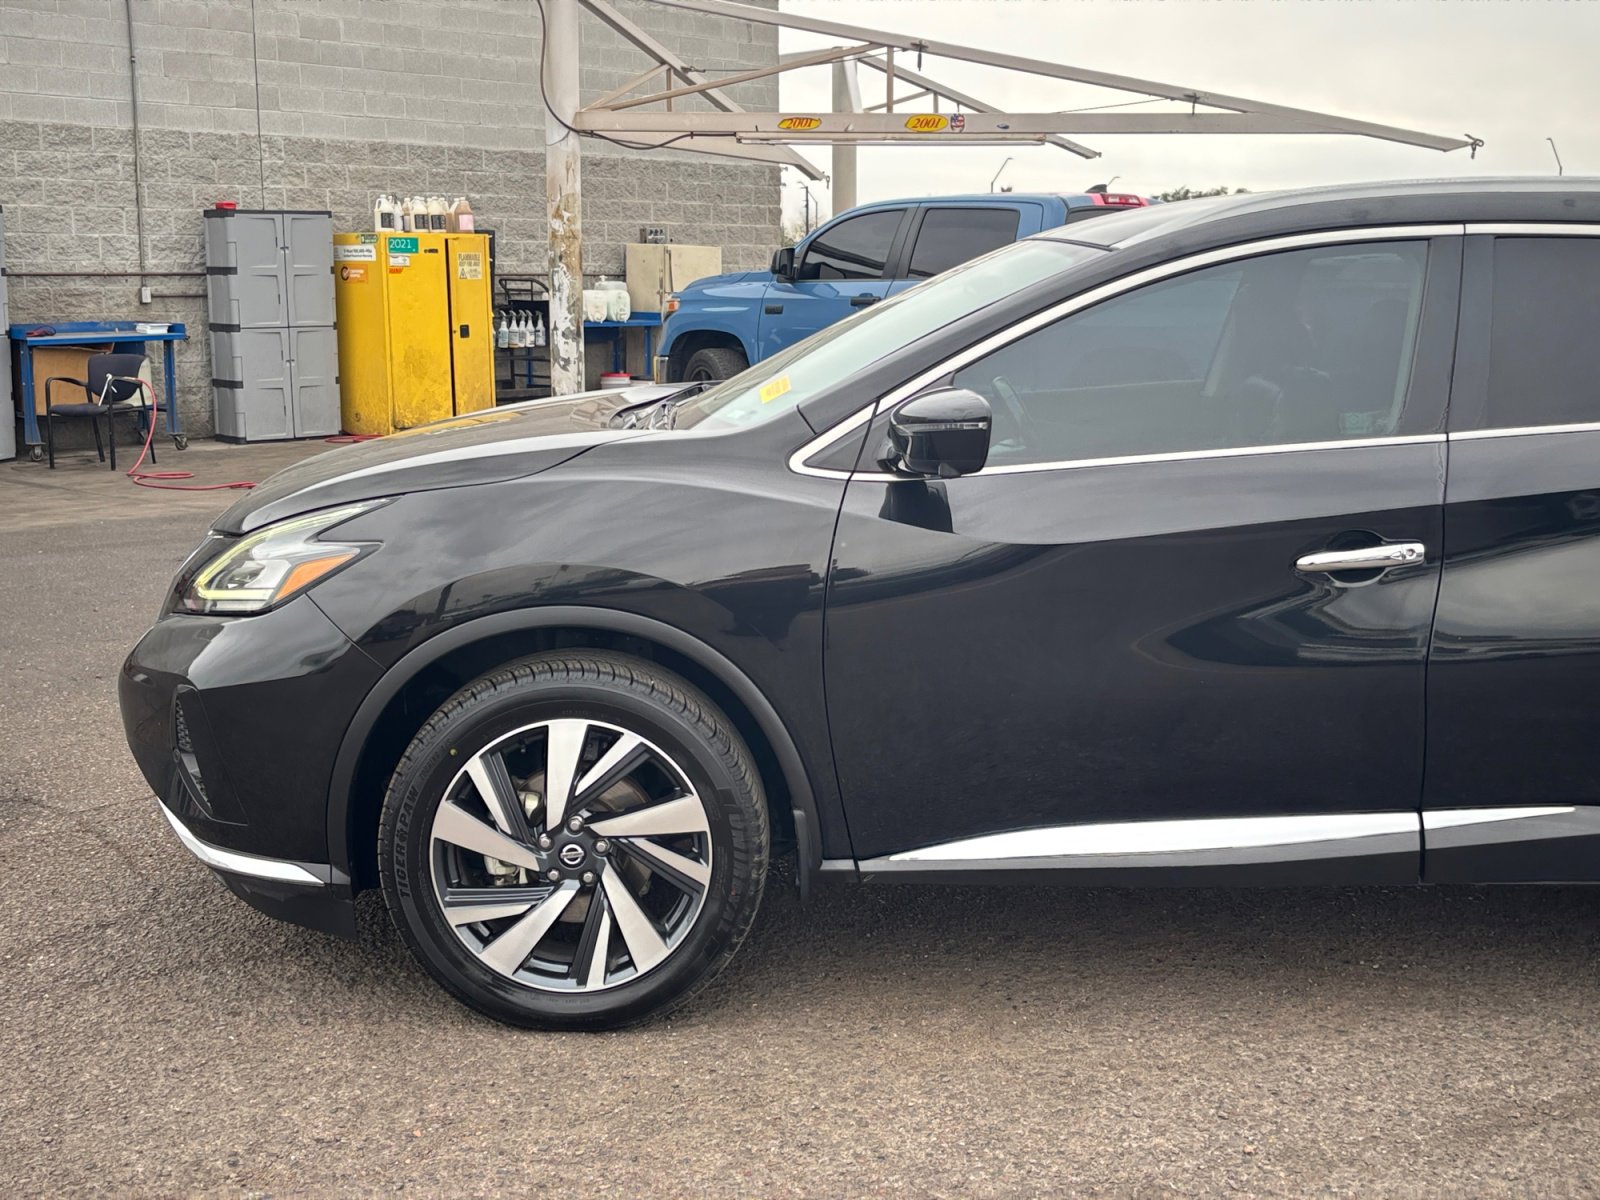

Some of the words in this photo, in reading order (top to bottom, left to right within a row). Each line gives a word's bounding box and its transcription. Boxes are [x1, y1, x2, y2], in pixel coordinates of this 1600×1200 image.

[786, 118, 813, 129] 2001
[912, 118, 940, 129] 2001
[389, 239, 411, 249] 2021
[400, 786, 420, 825] PAW
[395, 845, 411, 898] TIGER
